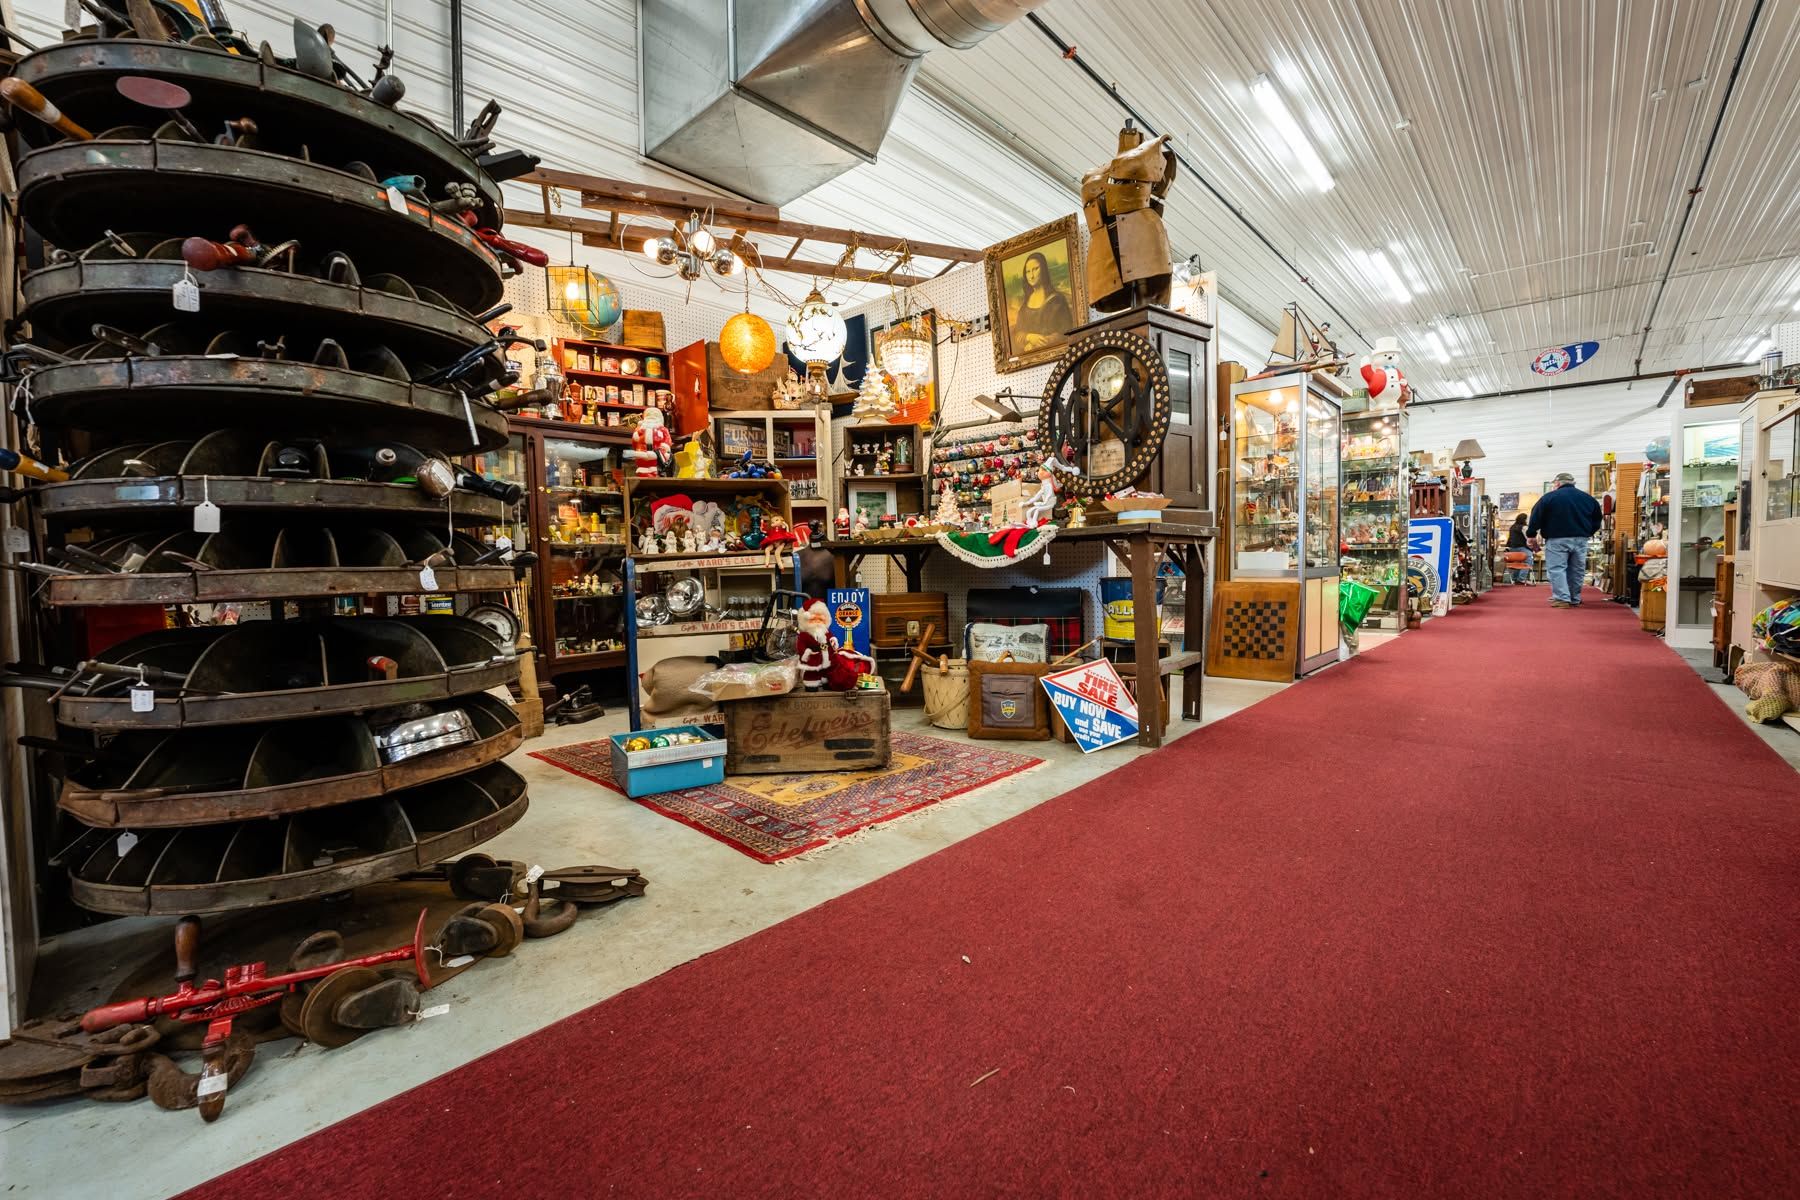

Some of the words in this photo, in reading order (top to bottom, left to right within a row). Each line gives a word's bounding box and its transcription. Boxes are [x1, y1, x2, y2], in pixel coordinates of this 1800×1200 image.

[1576, 349, 1584, 364] 1
[1408, 531, 1433, 554] M
[697, 558, 731, 567] WARD'S
[702, 621, 736, 632] WARD'S
[737, 620, 761, 630] CAKE
[1077, 681, 1118, 708] SALE
[1084, 672, 1118, 696] TIRE
[1053, 691, 1078, 711] BUY
[1079, 700, 1108, 720] NOW
[742, 710, 875, 754] Edelweiss
[1074, 717, 1089, 728] and
[1092, 717, 1122, 739] SAVE
[1090, 737, 1104, 746] card
